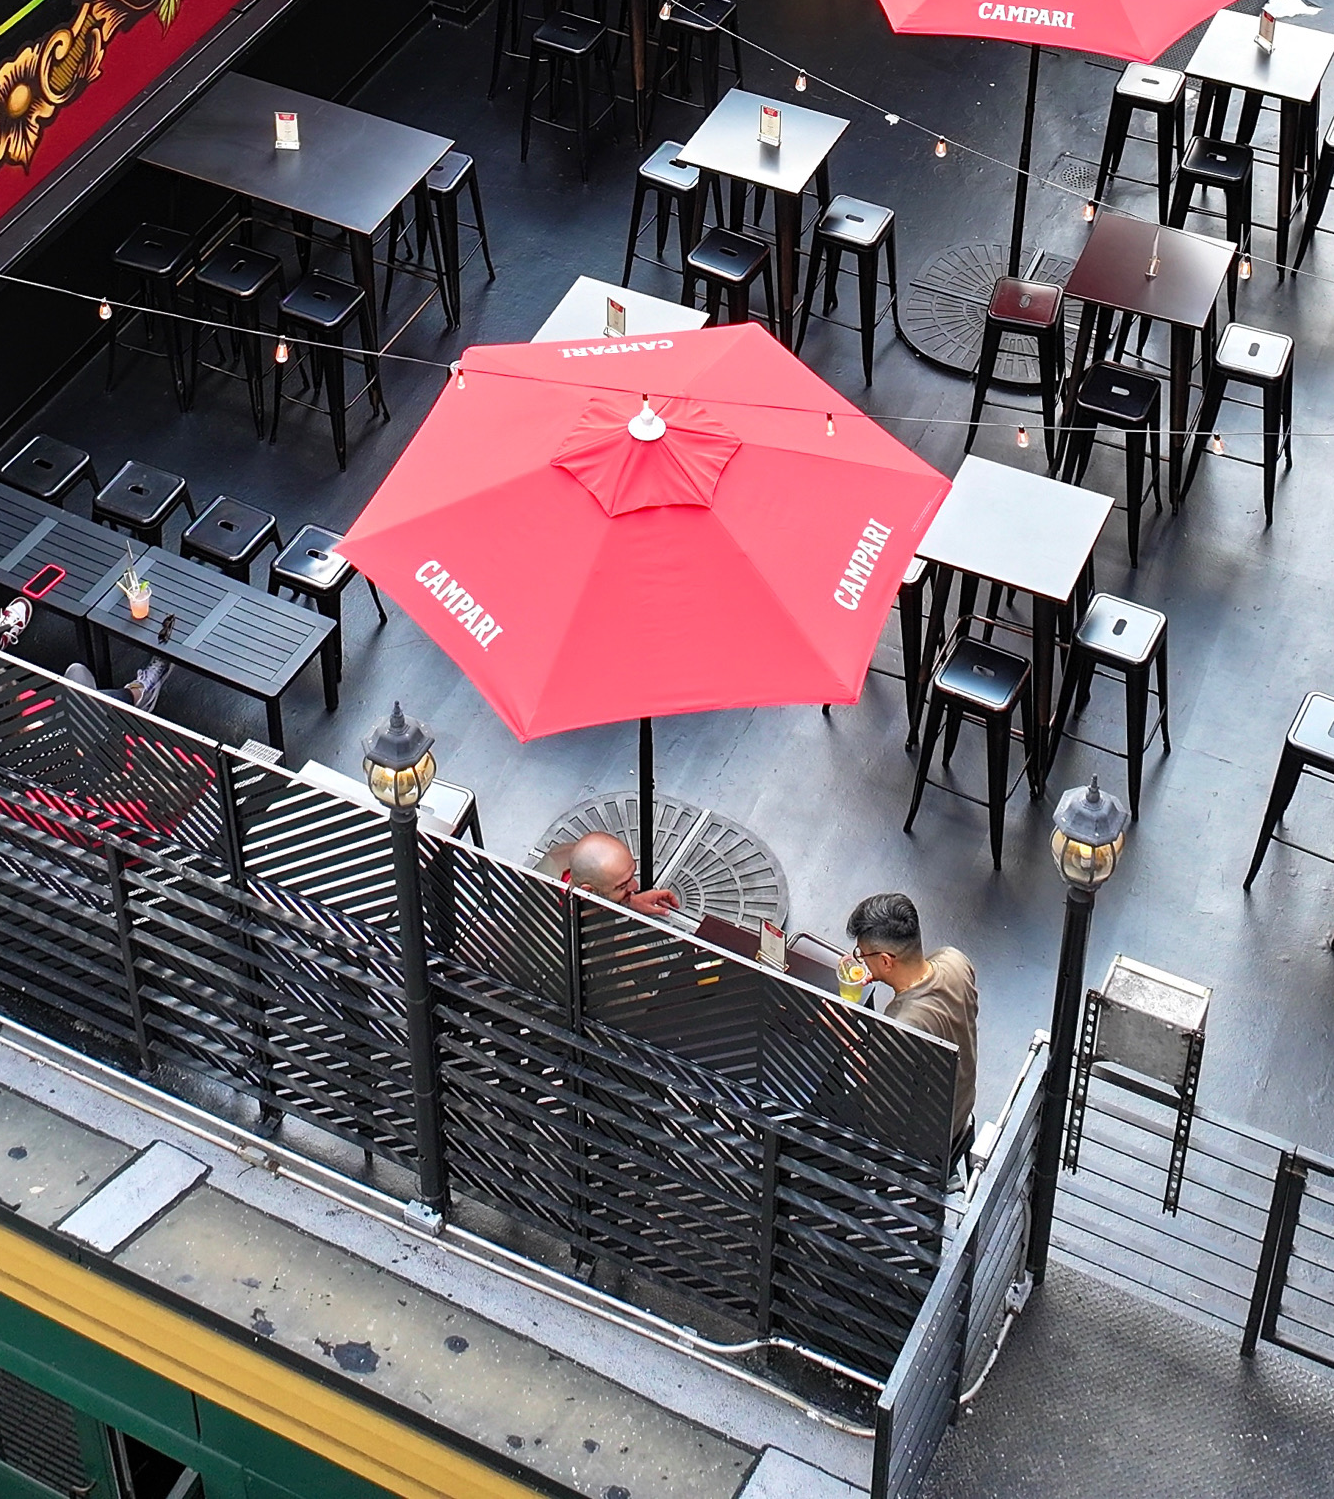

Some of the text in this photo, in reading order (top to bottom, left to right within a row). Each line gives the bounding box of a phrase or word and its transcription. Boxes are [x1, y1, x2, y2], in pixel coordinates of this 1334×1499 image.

[978, 2, 1074, 29] CAMPARI
[561, 340, 674, 358] CAMPARI
[833, 518, 892, 611] CAMPARI
[415, 560, 504, 648] CAMPARI
